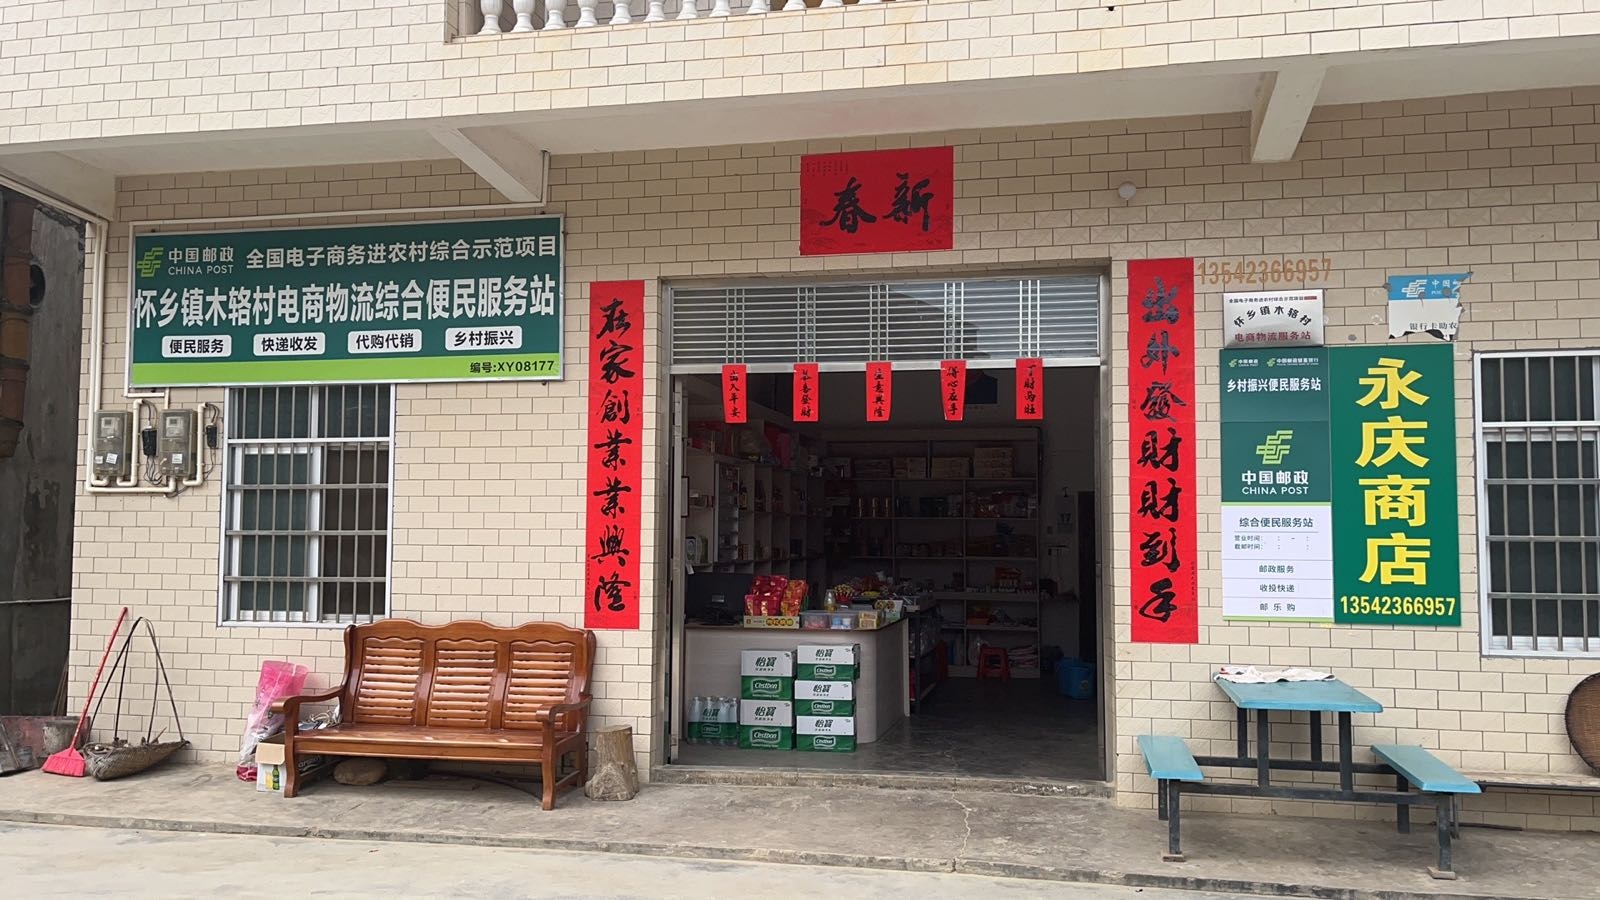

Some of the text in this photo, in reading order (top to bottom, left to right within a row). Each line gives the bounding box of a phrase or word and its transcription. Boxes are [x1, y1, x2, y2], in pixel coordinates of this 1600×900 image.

[168, 246, 234, 263] 中国邮政
[246, 235, 556, 269] 全国电子商务进农村综合示范项目
[168, 265, 234, 275] CHINA POST
[1197, 258, 1331, 285] 13542366957
[134, 273, 555, 328] 怀乡镇木辂村电商物流综合便民服务站
[261, 335, 318, 352] 快递收发
[356, 332, 414, 350] 代购代销
[454, 330, 514, 347] 乡村振兴
[1235, 331, 1311, 343] 电商物流服务站
[169, 338, 224, 354] 便民服务
[1227, 377, 1321, 393] 乡村振兴便民服务站
[1241, 470, 1309, 485] 中国邮政
[1355, 357, 1430, 585] 永庆商店
[1242, 486, 1309, 495] CHINA POST
[1240, 517, 1313, 528] 综合便民服务站
[1259, 565, 1294, 574] 邮政服务
[1259, 584, 1295, 593] 收投快递
[1340, 595, 1456, 616] 13542366957
